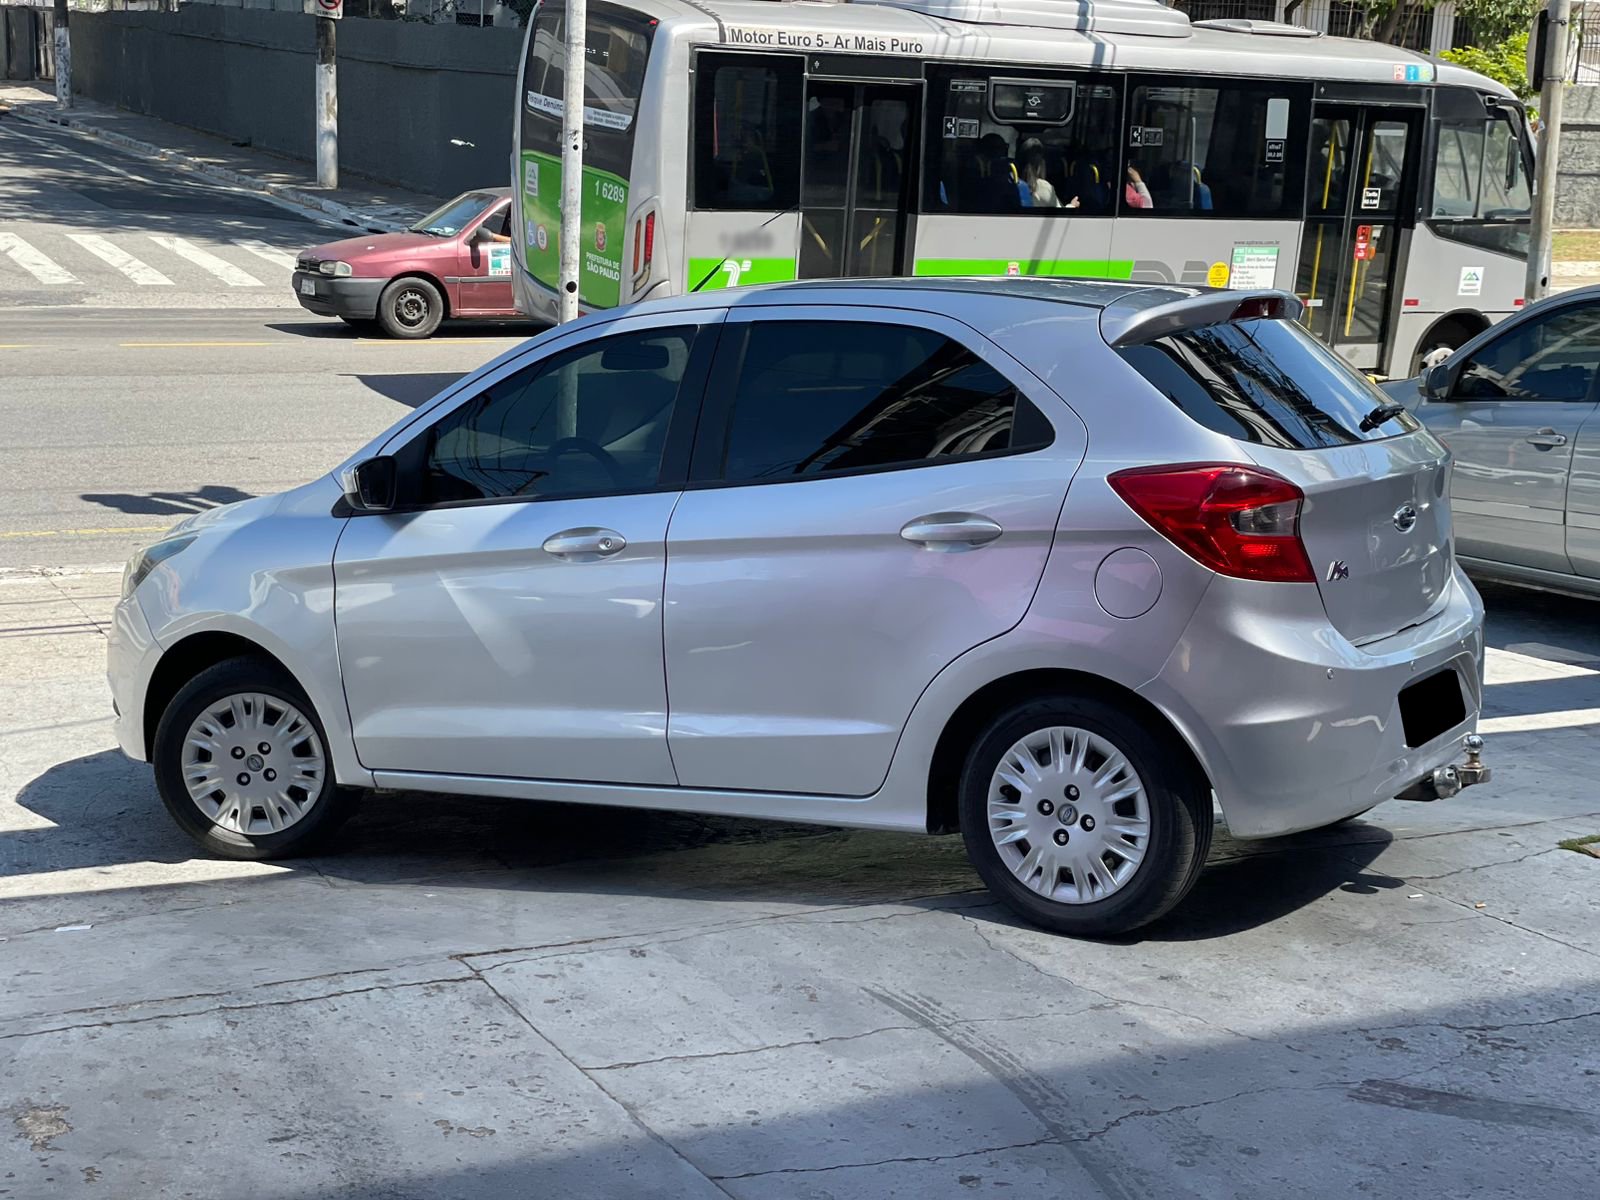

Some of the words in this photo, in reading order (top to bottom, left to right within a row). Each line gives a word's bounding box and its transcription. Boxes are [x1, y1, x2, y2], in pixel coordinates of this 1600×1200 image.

[731, 28, 773, 44] Motor
[777, 31, 811, 47] Euro
[834, 35, 850, 49] Ar
[855, 36, 886, 51] Mais
[891, 38, 923, 53] Puro
[602, 182, 625, 204] 6289
[586, 251, 612, 267] PREFEITURA
[612, 261, 620, 270] DE
[586, 261, 599, 274] SÃO
[599, 266, 620, 281] PAULO
